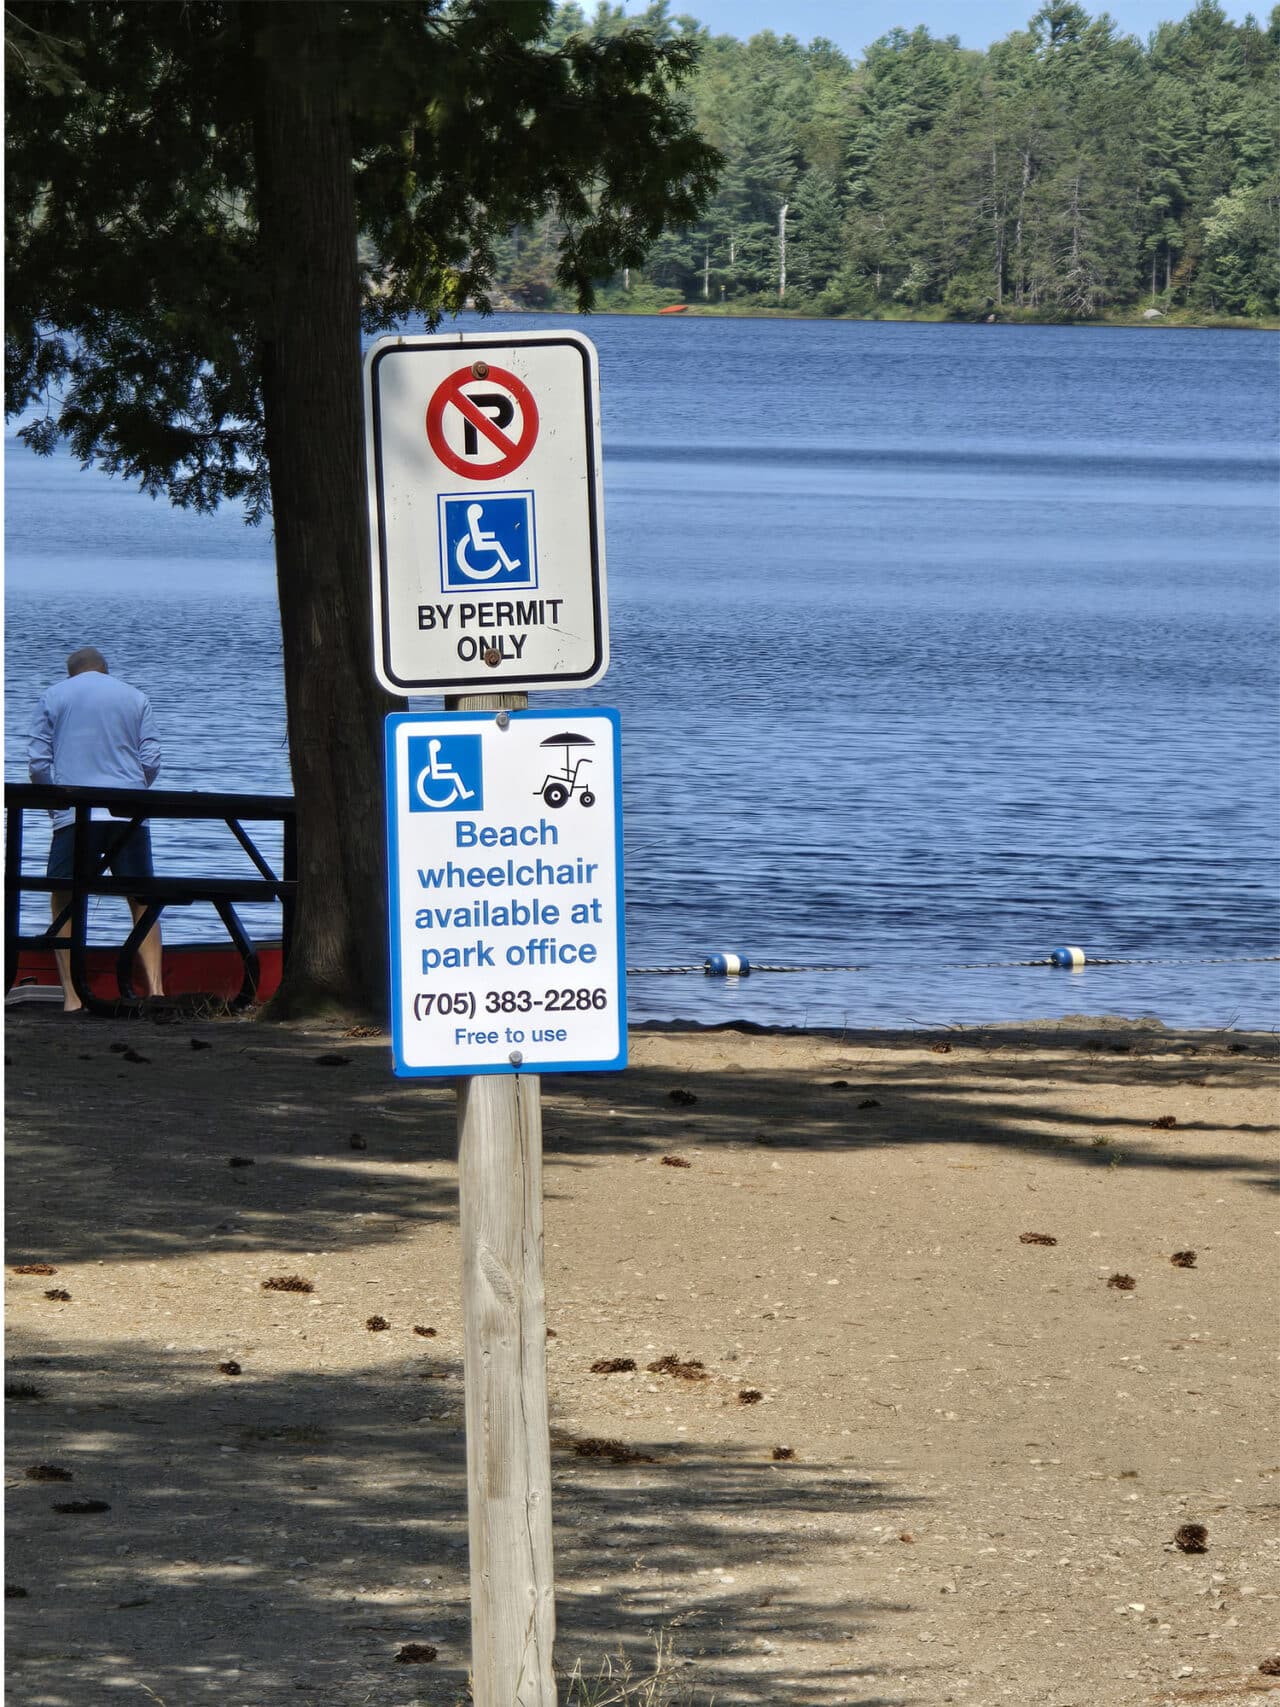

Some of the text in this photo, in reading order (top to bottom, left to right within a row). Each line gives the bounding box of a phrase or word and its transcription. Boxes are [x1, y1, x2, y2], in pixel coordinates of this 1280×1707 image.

[418, 599, 563, 630] BY PERMIT
[457, 634, 528, 662] ONLY
[455, 818, 558, 848] Beach
[417, 857, 598, 888] wheelchair
[415, 898, 602, 928] available at
[421, 938, 597, 974] park office
[413, 988, 607, 1020] (705) 383-2286
[455, 1027, 567, 1045] Free to use
